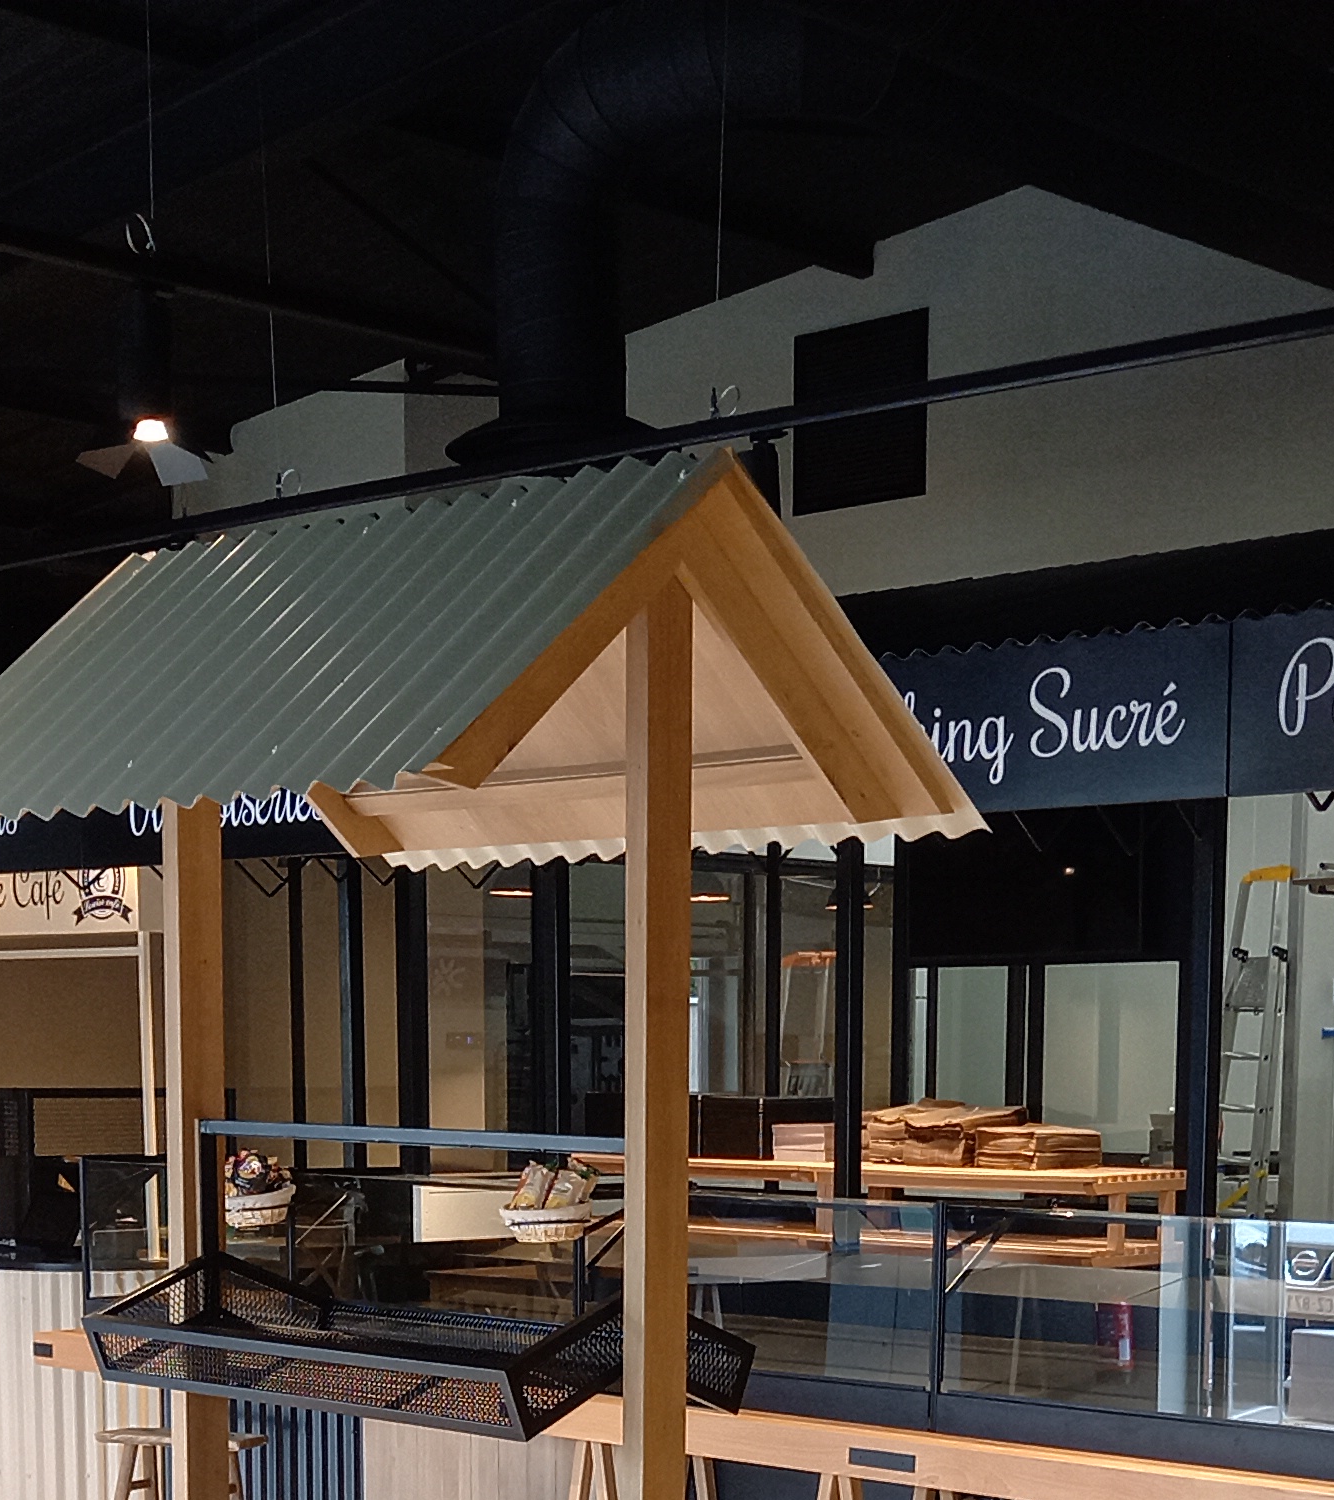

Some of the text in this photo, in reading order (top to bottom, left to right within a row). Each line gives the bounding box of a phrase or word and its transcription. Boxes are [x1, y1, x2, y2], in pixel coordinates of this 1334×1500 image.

[904, 666, 1186, 785] ing Sucré
[11, 869, 66, 921] Café
